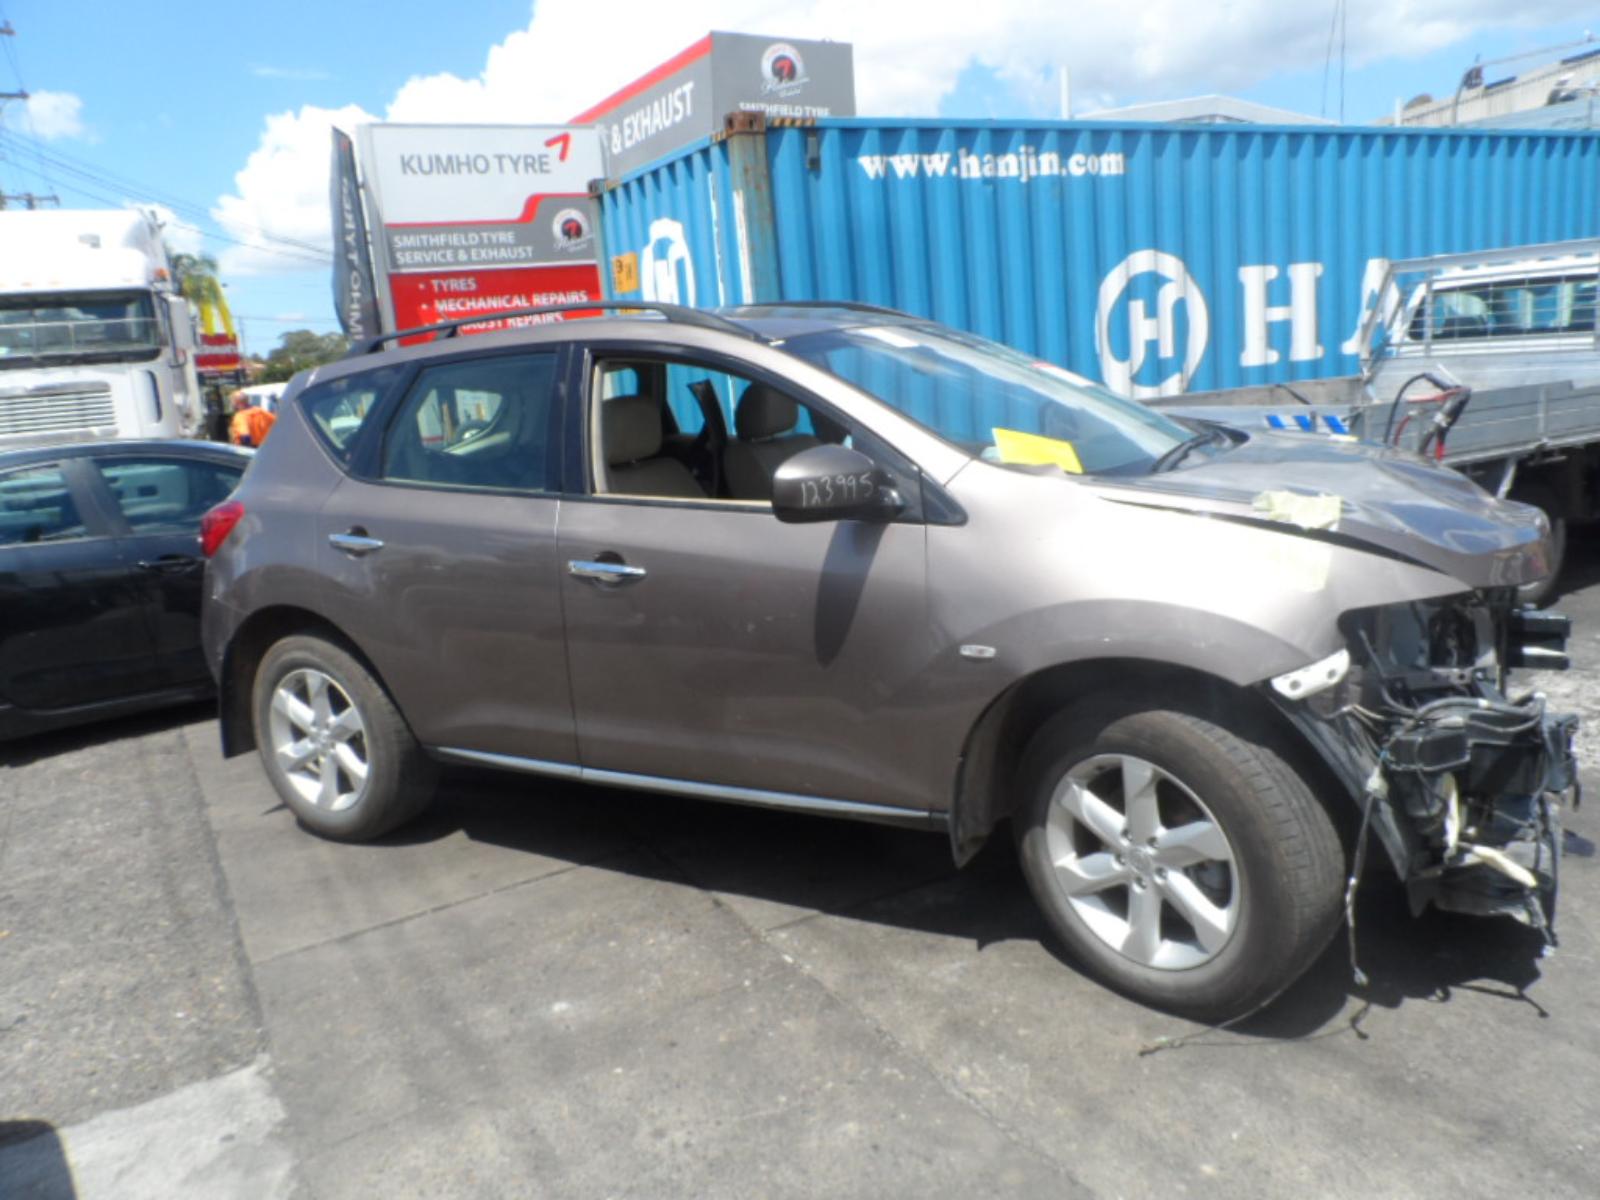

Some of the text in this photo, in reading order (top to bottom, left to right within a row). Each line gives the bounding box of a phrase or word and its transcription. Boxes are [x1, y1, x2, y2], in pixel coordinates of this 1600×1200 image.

[611, 81, 694, 155] & EXHAUST
[401, 153, 551, 175] KUMHO TYRE
[858, 145, 1125, 182] www.hanjin.com
[393, 231, 516, 248] SMITHFIELD TYRE
[396, 246, 533, 265] SERVICE & EXHAUST
[431, 277, 477, 294] TYRES
[434, 290, 588, 313] MECHANICAL REPAIRS
